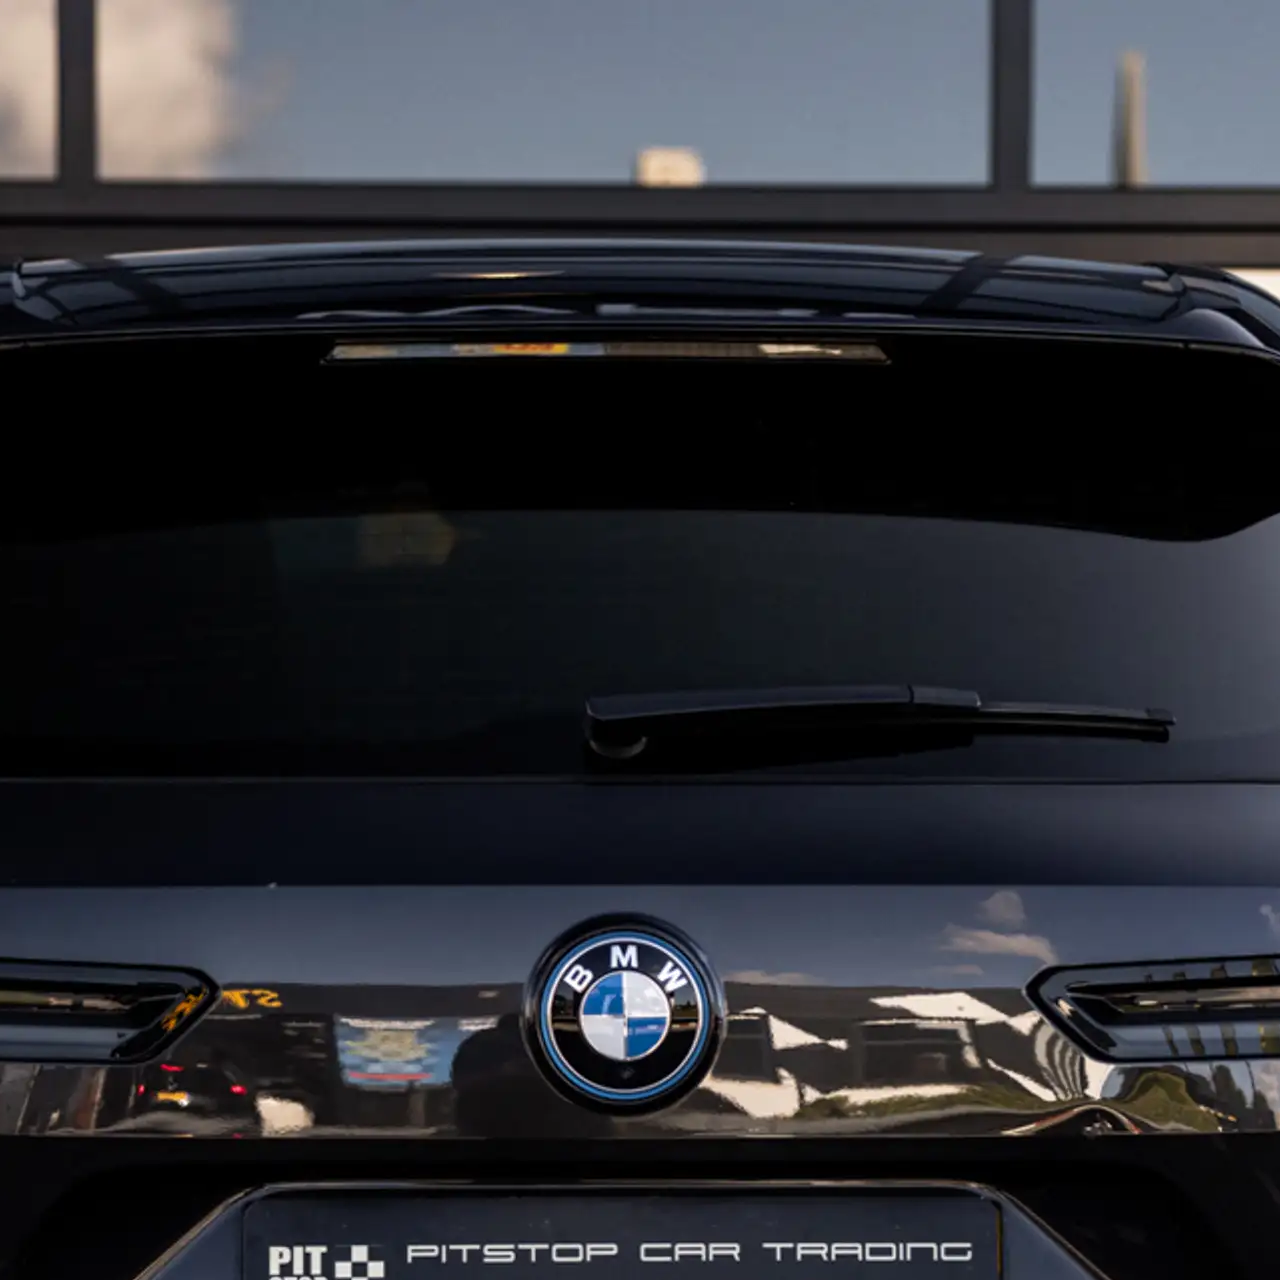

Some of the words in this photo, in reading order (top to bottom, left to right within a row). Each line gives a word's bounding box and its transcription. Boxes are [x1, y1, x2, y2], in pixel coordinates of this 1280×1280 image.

[563, 944, 688, 993] BMW
[268, 1245, 328, 1275] PIT
[407, 1243, 619, 1263] PITSTOP
[640, 1243, 741, 1262] CAR
[762, 1243, 973, 1262] TRADING
